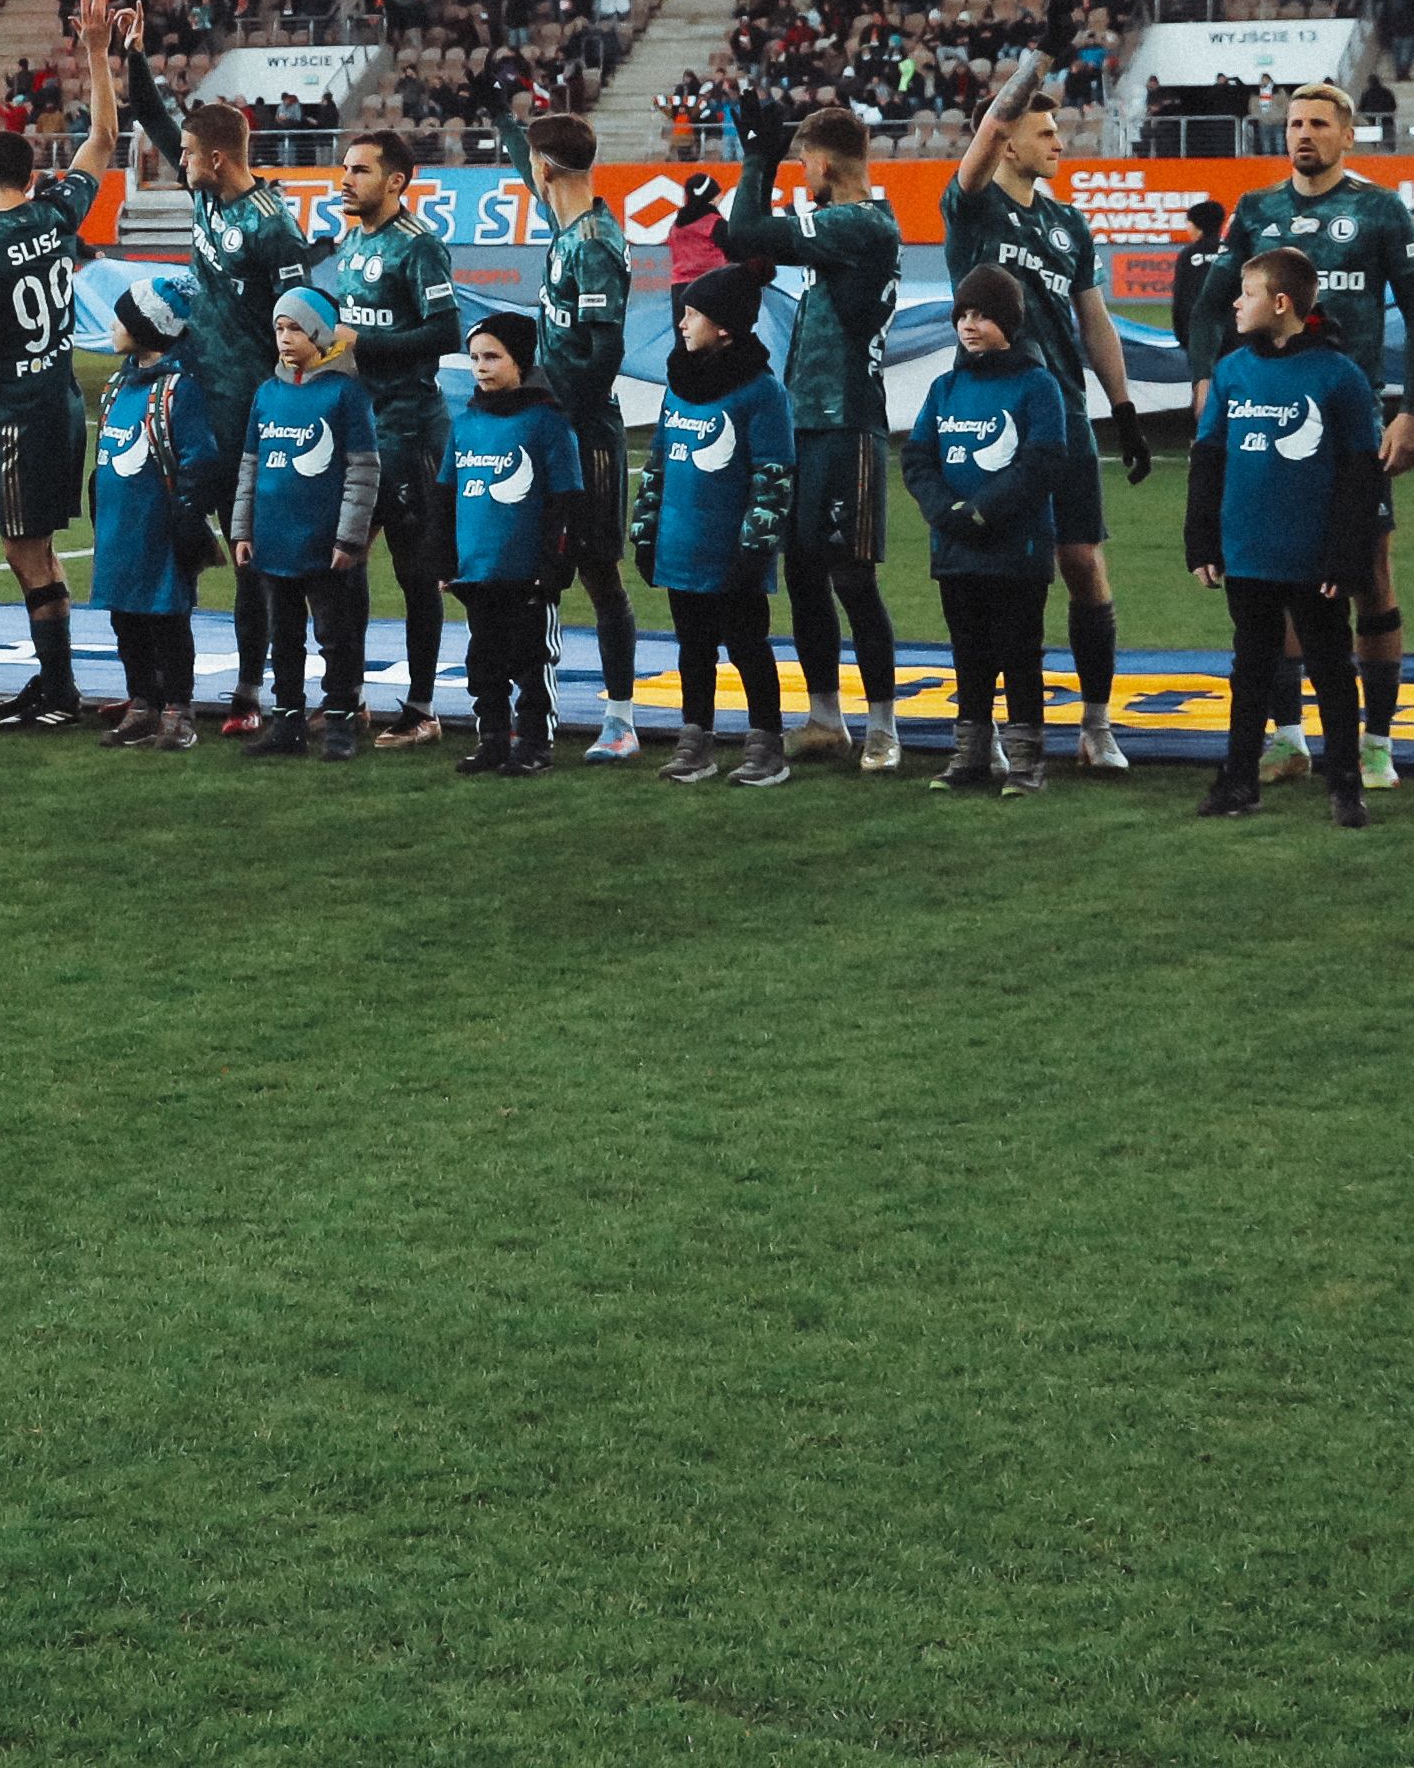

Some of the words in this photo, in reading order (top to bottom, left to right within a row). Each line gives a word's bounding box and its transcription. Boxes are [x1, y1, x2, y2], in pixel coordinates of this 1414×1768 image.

[267, 55, 333, 67] WYJŚCIE
[1070, 170, 1146, 191] CAŁE
[7, 227, 62, 266] SLISZ
[12, 256, 74, 353] 99
[1227, 399, 1300, 427] Zobaczyć
[1239, 431, 1270, 451] Lili
